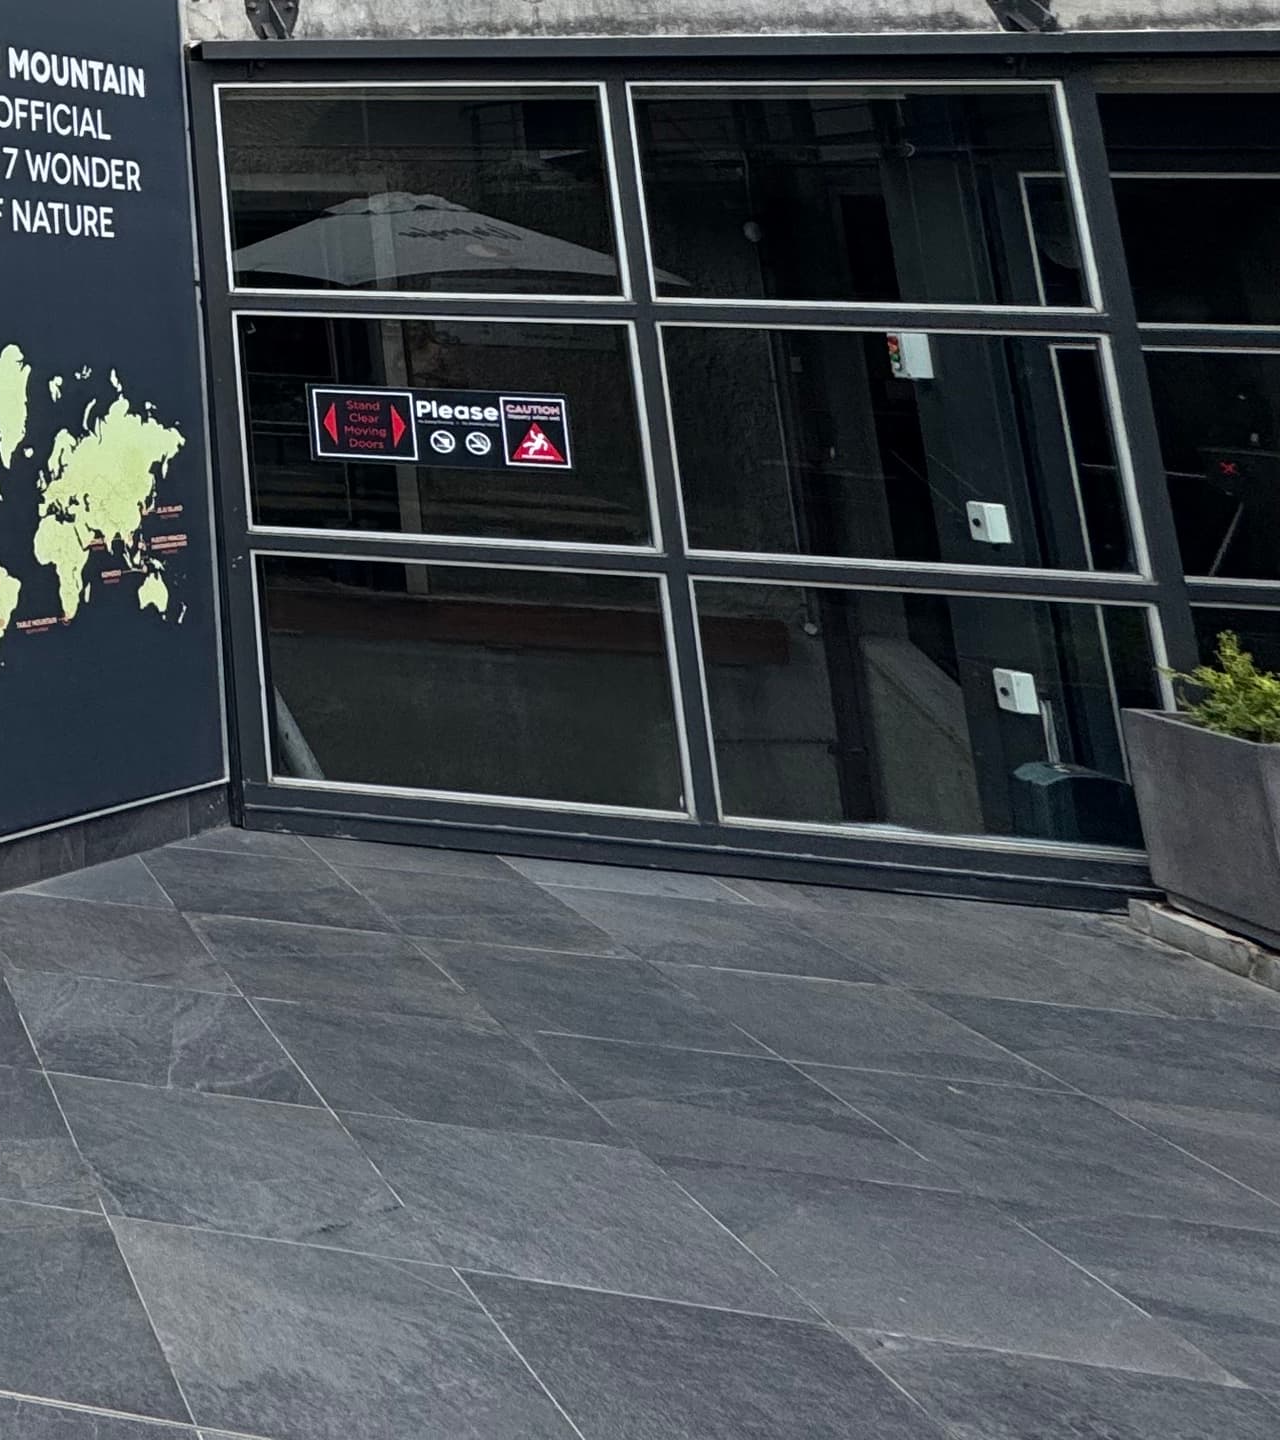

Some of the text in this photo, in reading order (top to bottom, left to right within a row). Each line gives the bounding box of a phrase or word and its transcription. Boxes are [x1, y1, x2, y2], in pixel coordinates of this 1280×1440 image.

[8, 47, 146, 98] MOUNTAIN
[2, 146, 19, 179] 7
[26, 149, 142, 192] WONDER
[12, 198, 115, 239] NATURE
[346, 399, 381, 411] Stand
[415, 400, 499, 421] Please
[505, 403, 560, 416] CAUTION
[348, 412, 380, 423] Clear
[344, 425, 387, 439] Moving
[348, 438, 385, 449] Doors
